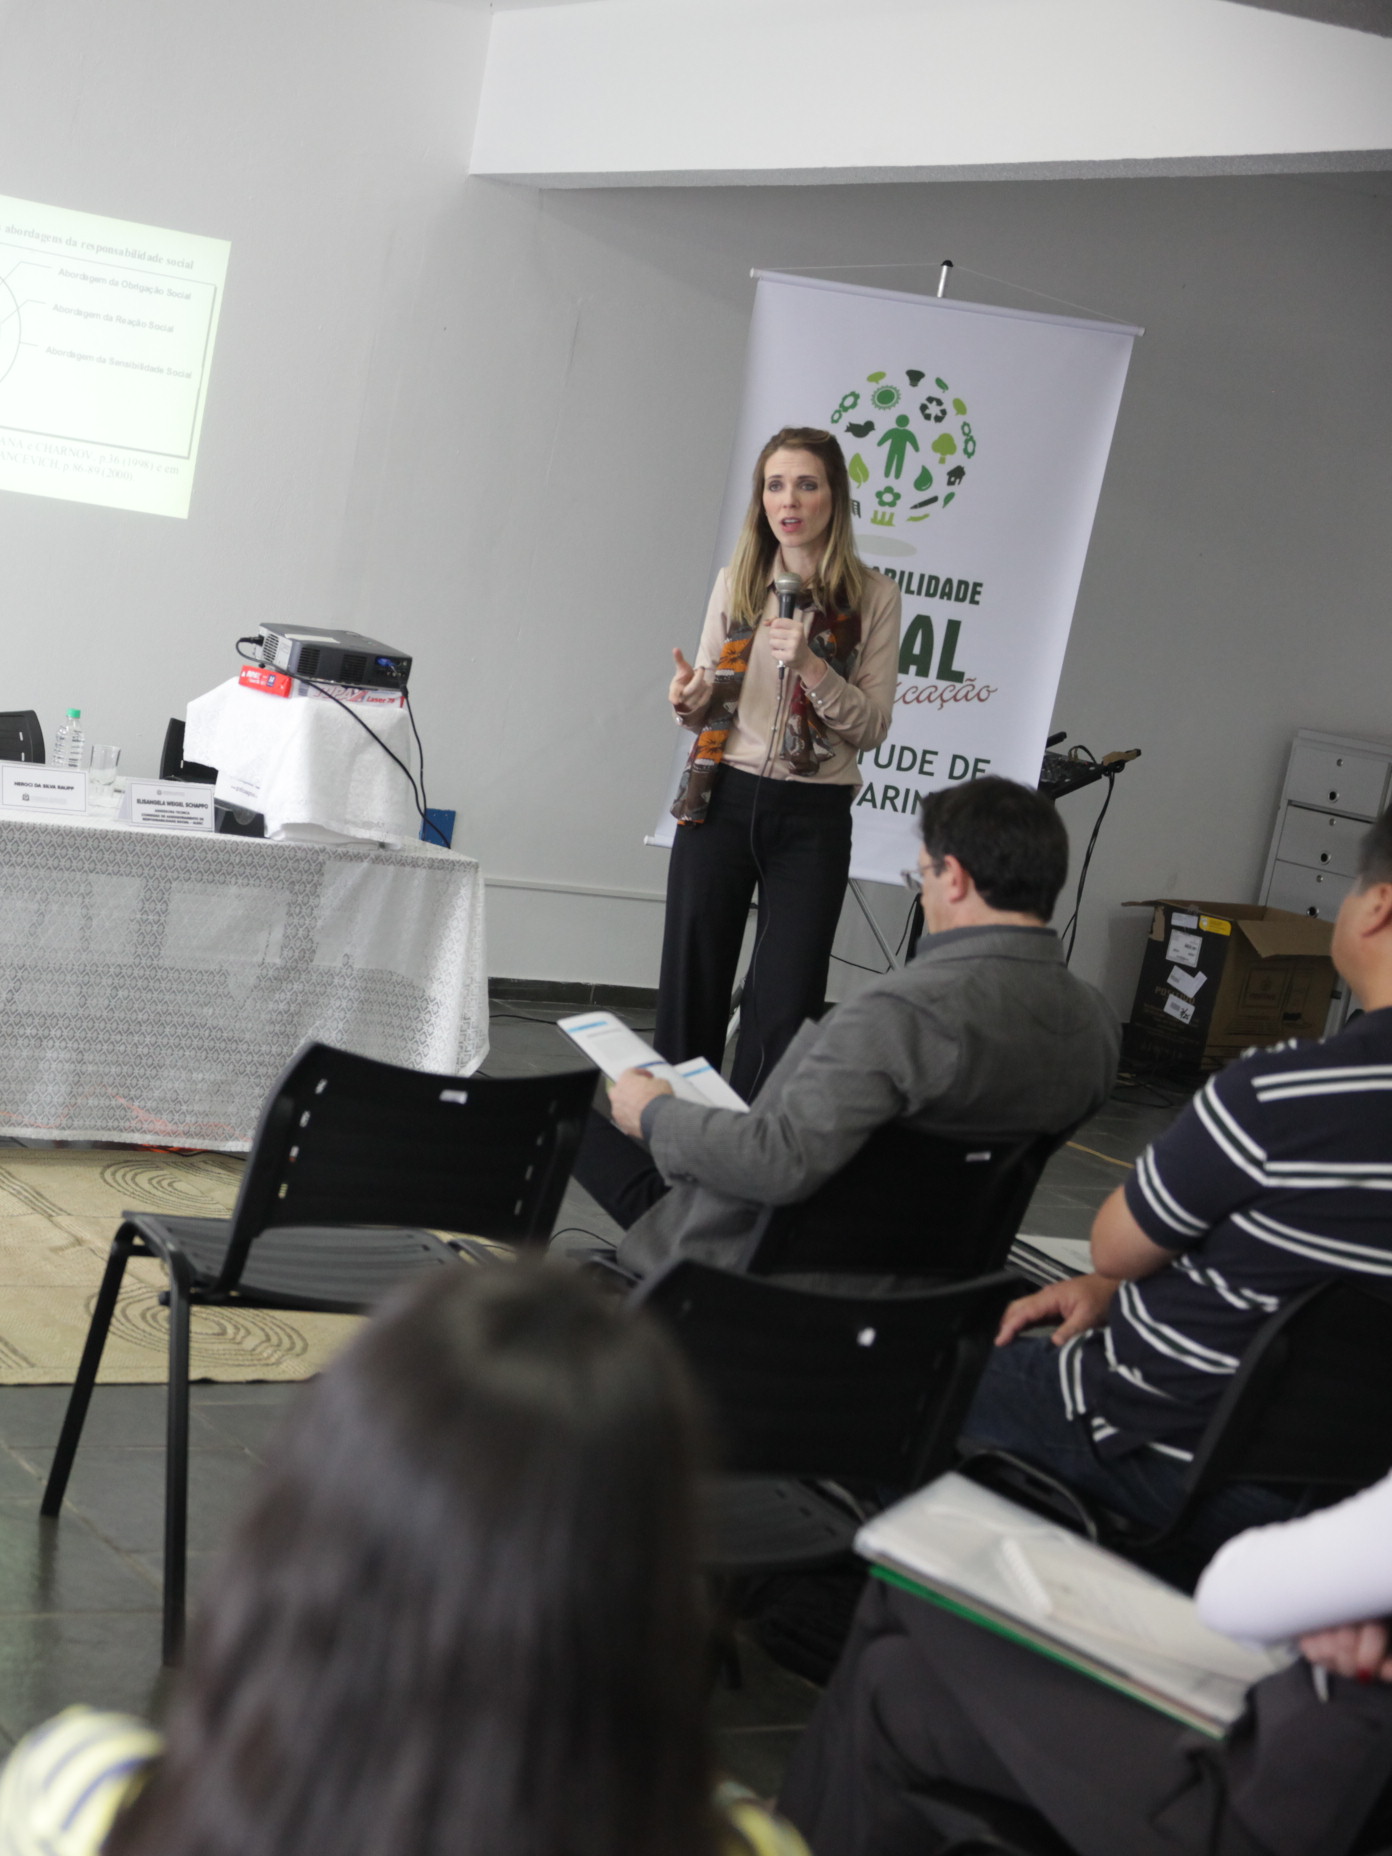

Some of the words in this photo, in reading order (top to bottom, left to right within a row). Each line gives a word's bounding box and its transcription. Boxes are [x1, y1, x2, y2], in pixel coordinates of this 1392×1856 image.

[5, 224, 62, 244] abordagens
[65, 236, 77, 247] da
[81, 240, 163, 263] responsabilidade
[166, 258, 194, 270] social
[58, 268, 107, 284] Abordagem
[121, 280, 164, 294] Obrigação
[167, 288, 191, 300] Social
[52, 304, 101, 319] Abordagem
[103, 313, 113, 322] da
[115, 315, 147, 328] Reação
[148, 321, 174, 333] Social
[45, 346, 94, 361] Abordagem
[96, 355, 106, 364] da
[108, 357, 164, 374] Sensibilidade
[166, 367, 192, 379] Social
[898, 614, 965, 684] AL
[948, 754, 991, 780] DE
